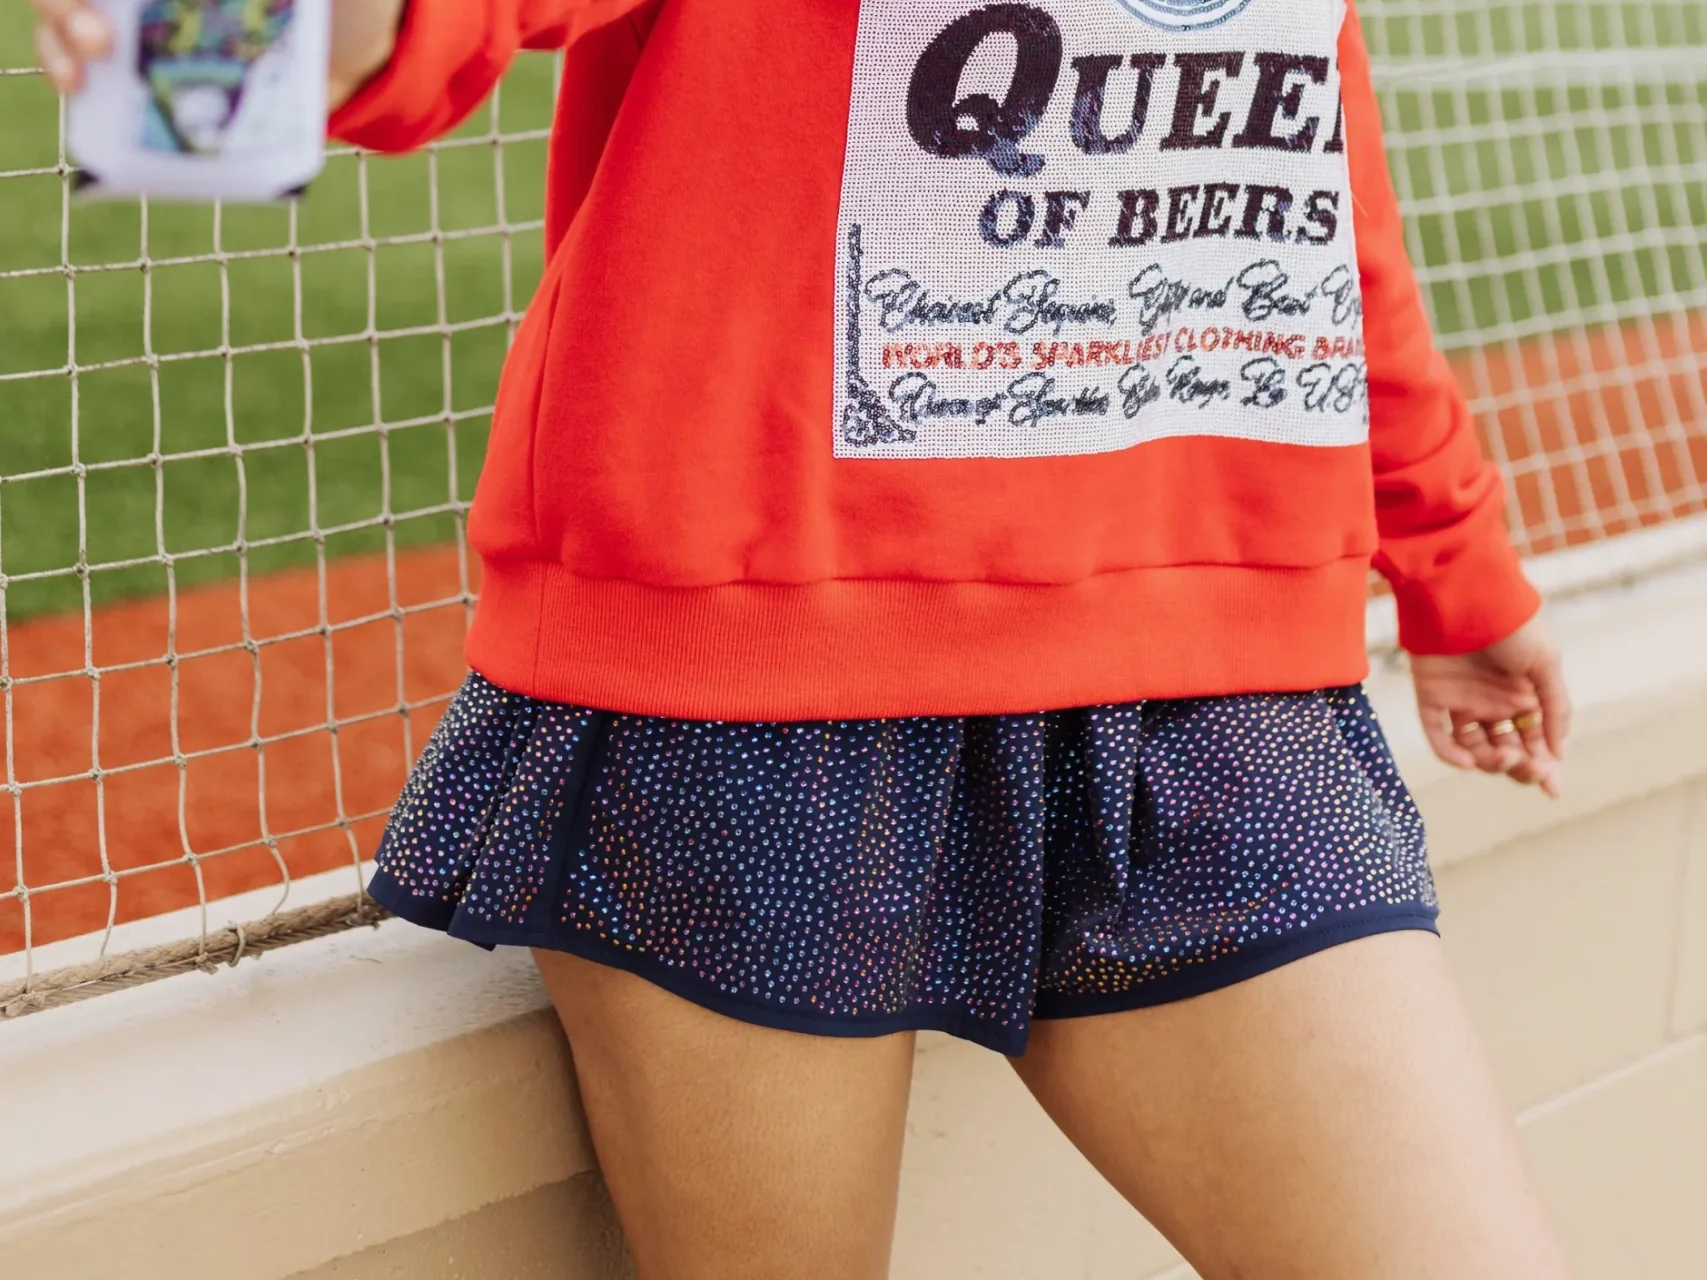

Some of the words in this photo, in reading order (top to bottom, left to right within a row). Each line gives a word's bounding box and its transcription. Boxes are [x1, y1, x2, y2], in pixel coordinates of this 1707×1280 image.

[977, 189, 1090, 249] OF
[1108, 182, 1339, 249] BEERS
[1174, 326, 1306, 360] CLOTHING
